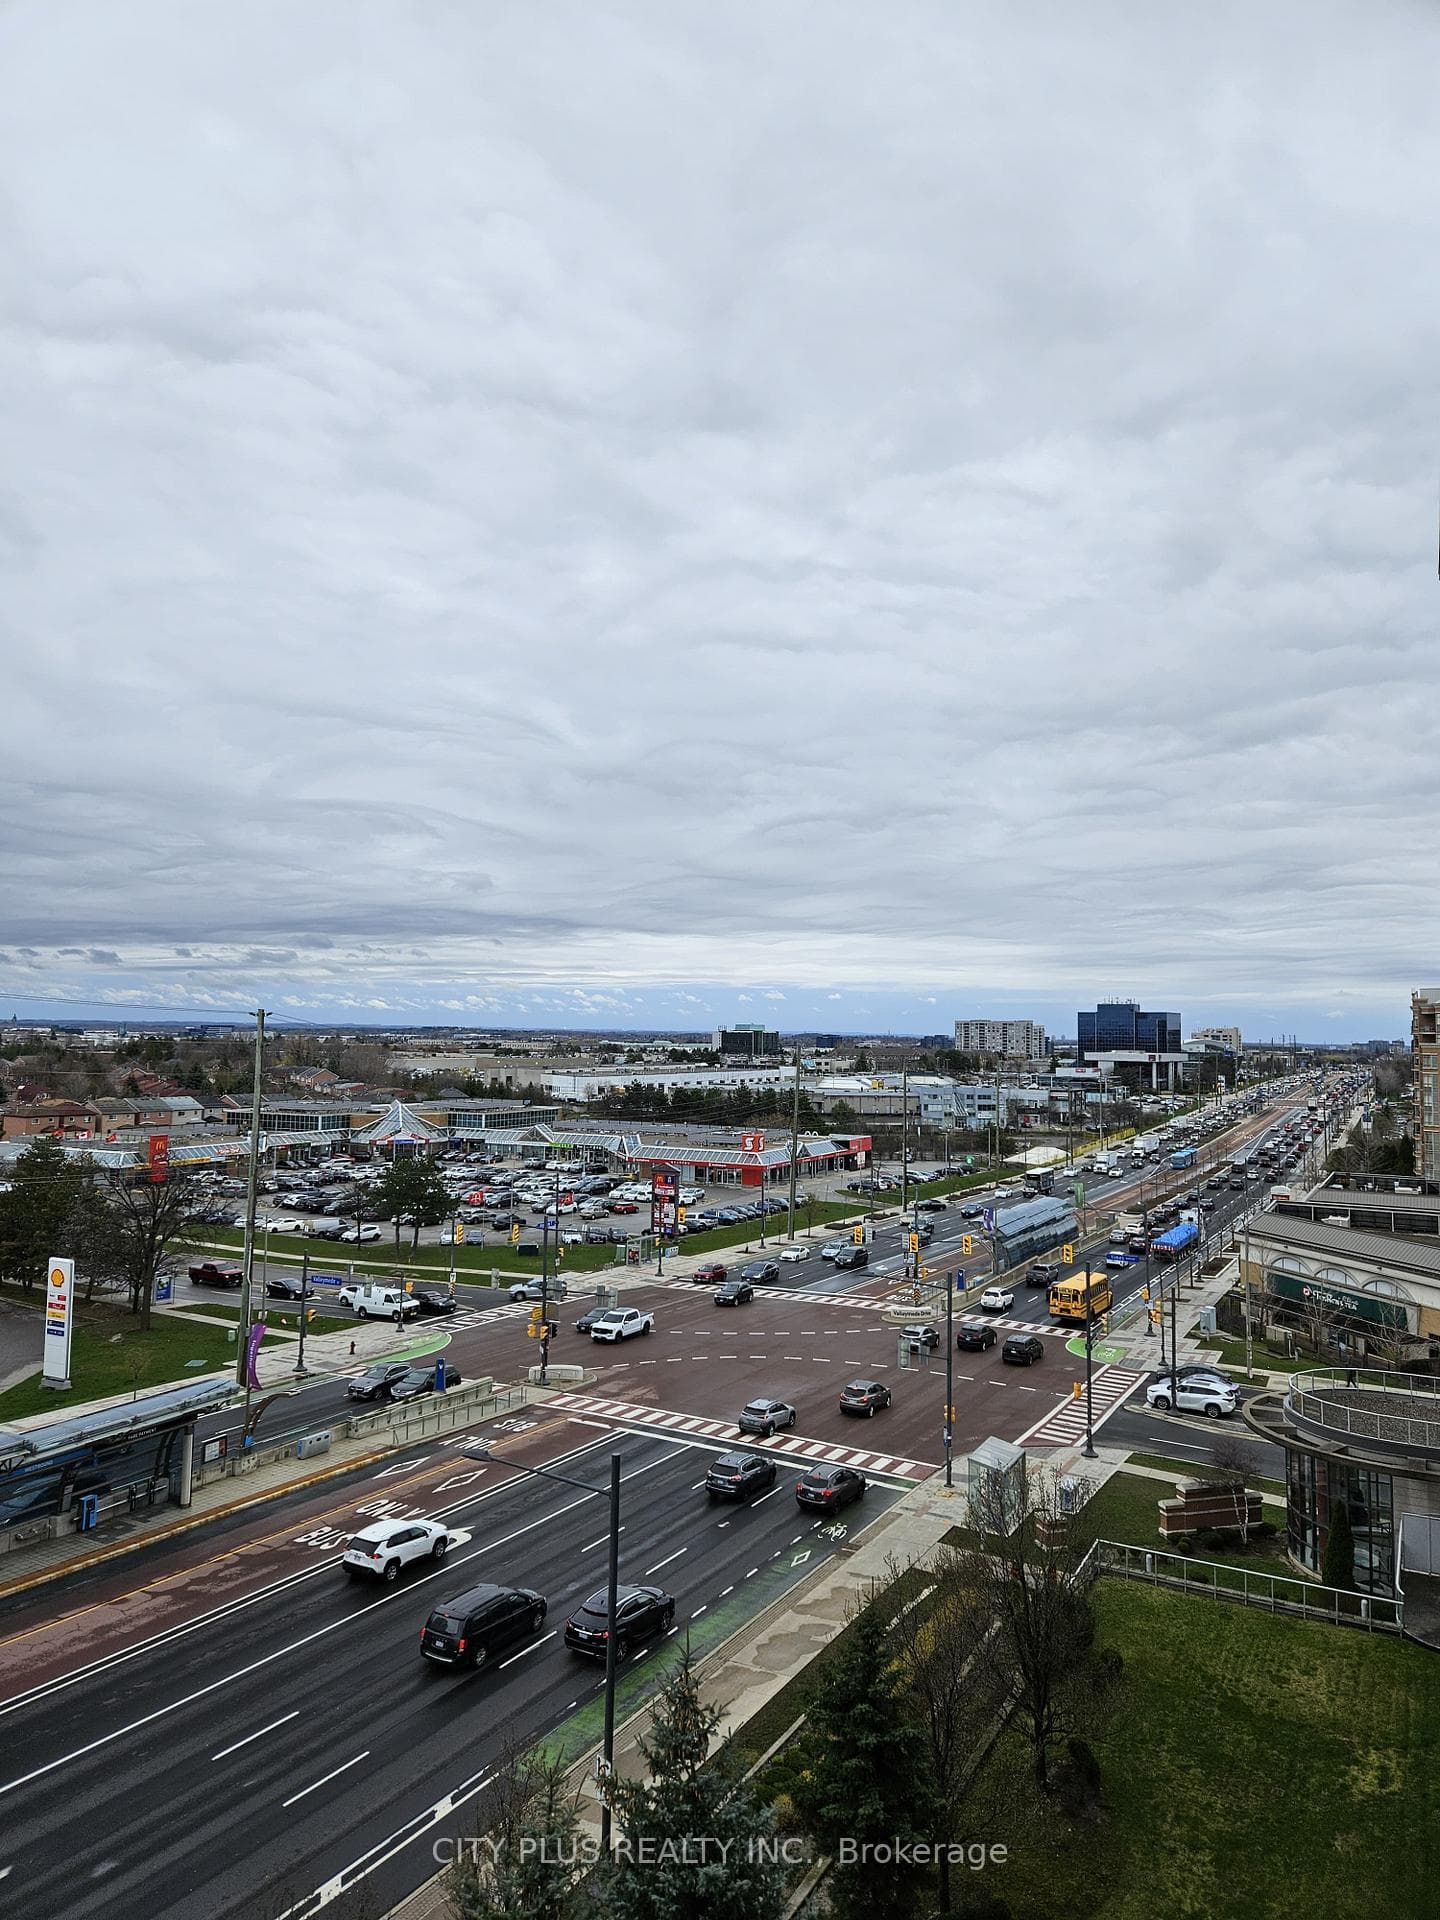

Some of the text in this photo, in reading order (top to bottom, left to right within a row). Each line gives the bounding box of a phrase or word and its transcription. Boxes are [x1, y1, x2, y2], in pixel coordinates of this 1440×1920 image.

[893, 1309, 920, 1318] Valleymede
[492, 1418, 539, 1433] BUS
[355, 1499, 427, 1520] ONLY
[293, 1526, 357, 1551] BUS
